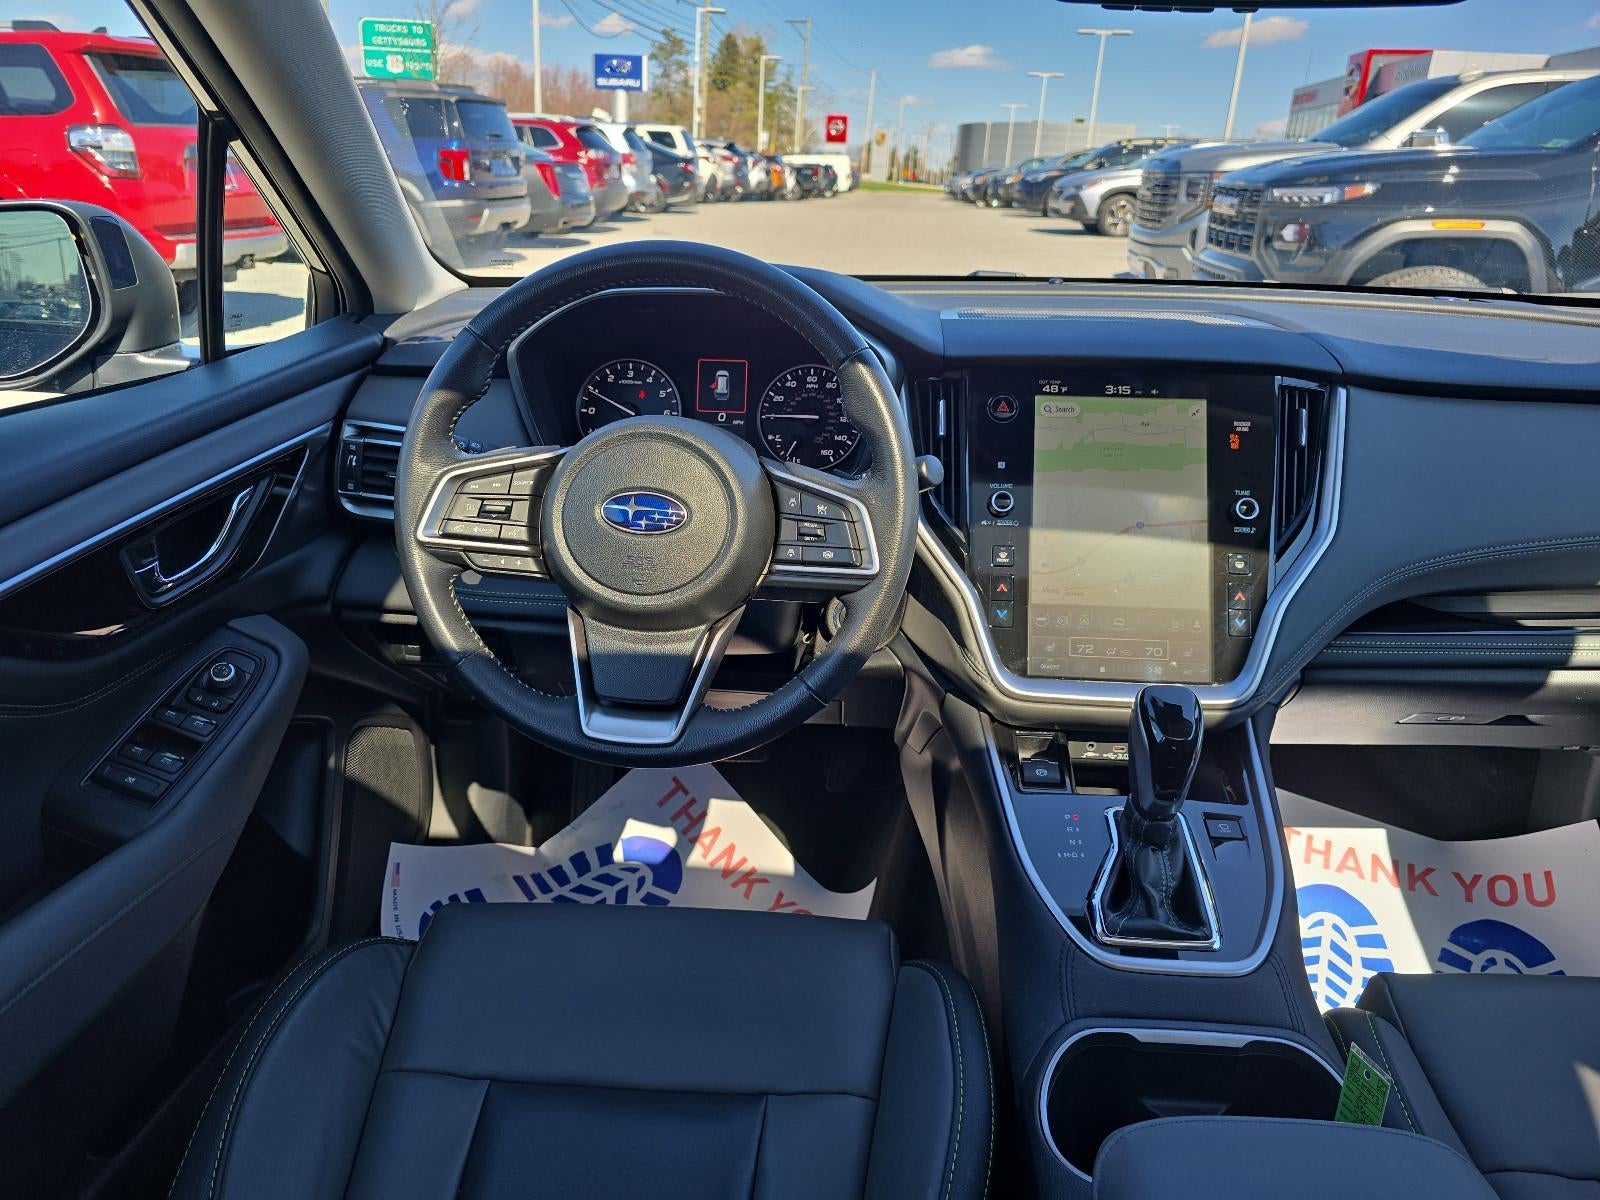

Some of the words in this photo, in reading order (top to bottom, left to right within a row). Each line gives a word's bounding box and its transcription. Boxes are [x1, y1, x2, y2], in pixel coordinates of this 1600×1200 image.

[374, 23, 408, 33] TRUCKS
[411, 25, 424, 34] TO
[371, 35, 428, 47] GETTYSBURG
[365, 58, 385, 68] USE
[596, 77, 641, 88] SUBARU
[607, 374, 615, 383] 2
[627, 370, 634, 378] 3
[646, 376, 653, 384] 4
[658, 390, 666, 398] 5
[1042, 385, 1059, 393] 48
[1104, 385, 1132, 395] 3:15
[587, 406, 596, 415] 0
[1055, 404, 1075, 413] Search
[717, 412, 727, 422] 0
[1076, 644, 1095, 654] 72
[1144, 647, 1163, 657] 70
[656, 775, 771, 901] THANK
[1283, 824, 1440, 898] THANK
[1451, 869, 1557, 908] YOU
[393, 914, 400, 923] IN
